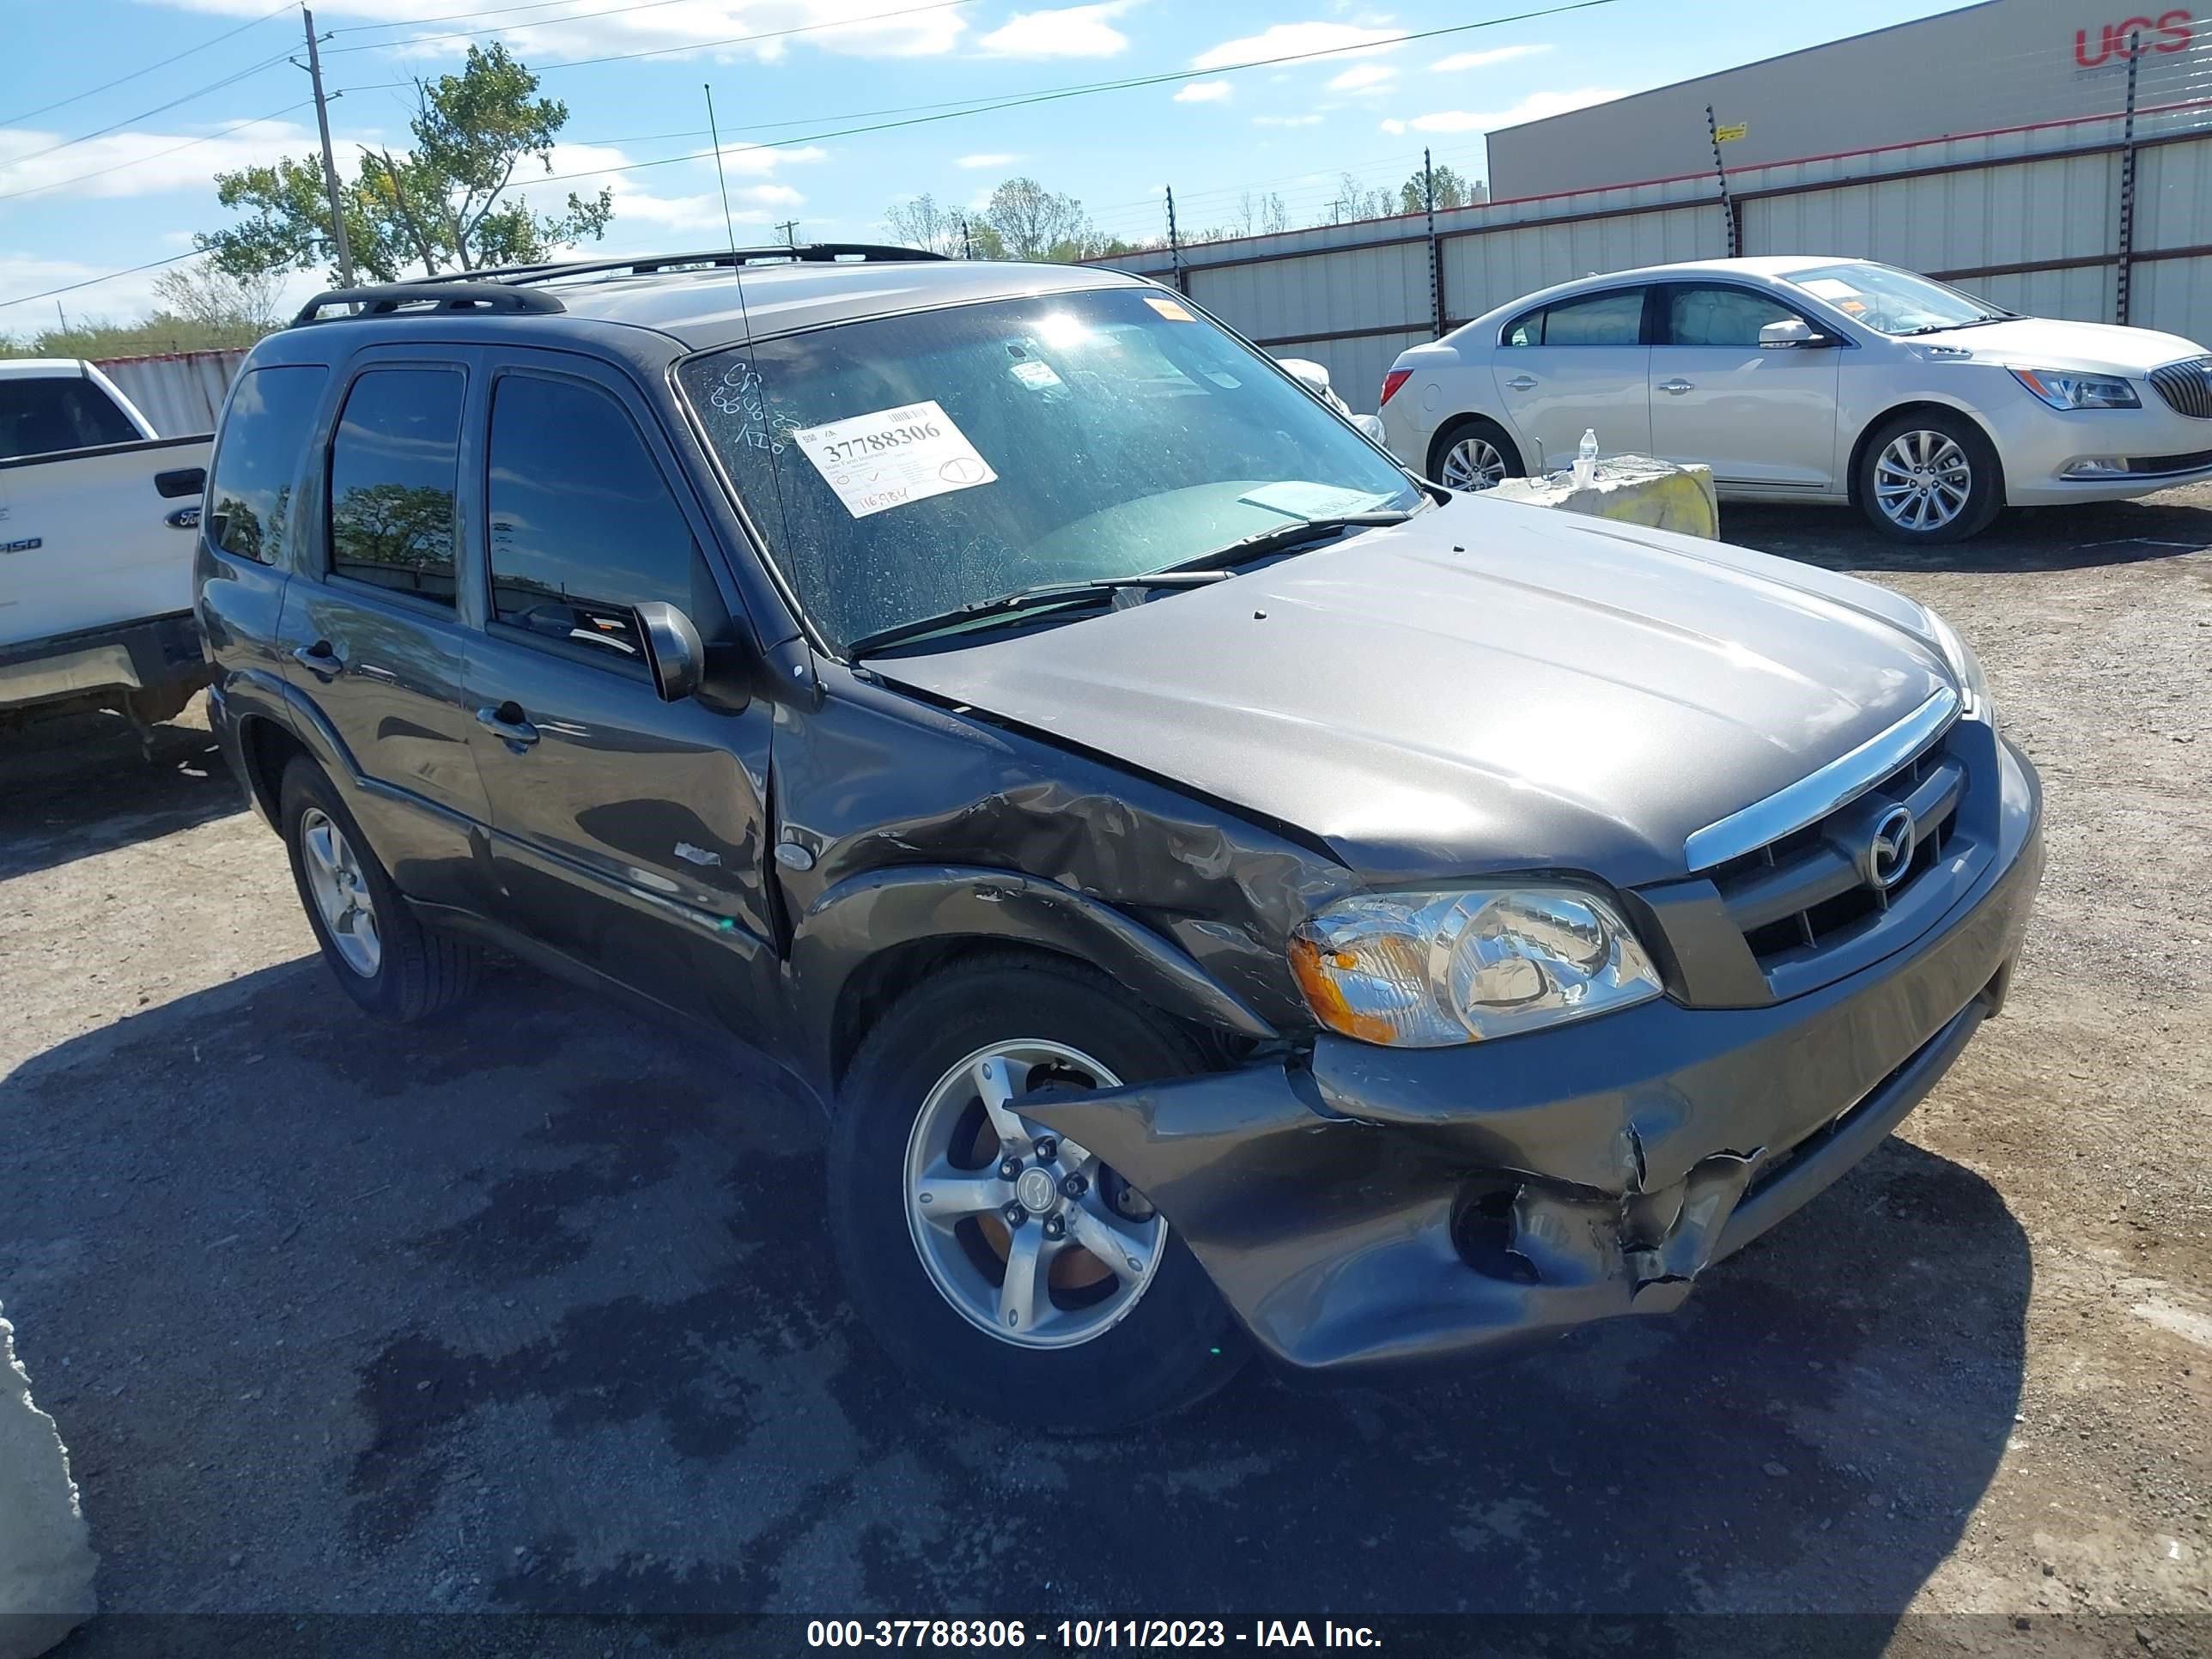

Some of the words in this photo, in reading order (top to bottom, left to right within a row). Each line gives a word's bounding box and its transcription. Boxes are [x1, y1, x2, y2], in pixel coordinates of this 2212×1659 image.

[2075, 9, 2192, 66] UCS
[823, 422, 941, 463] 37788306
[179, 510, 201, 526] Fo
